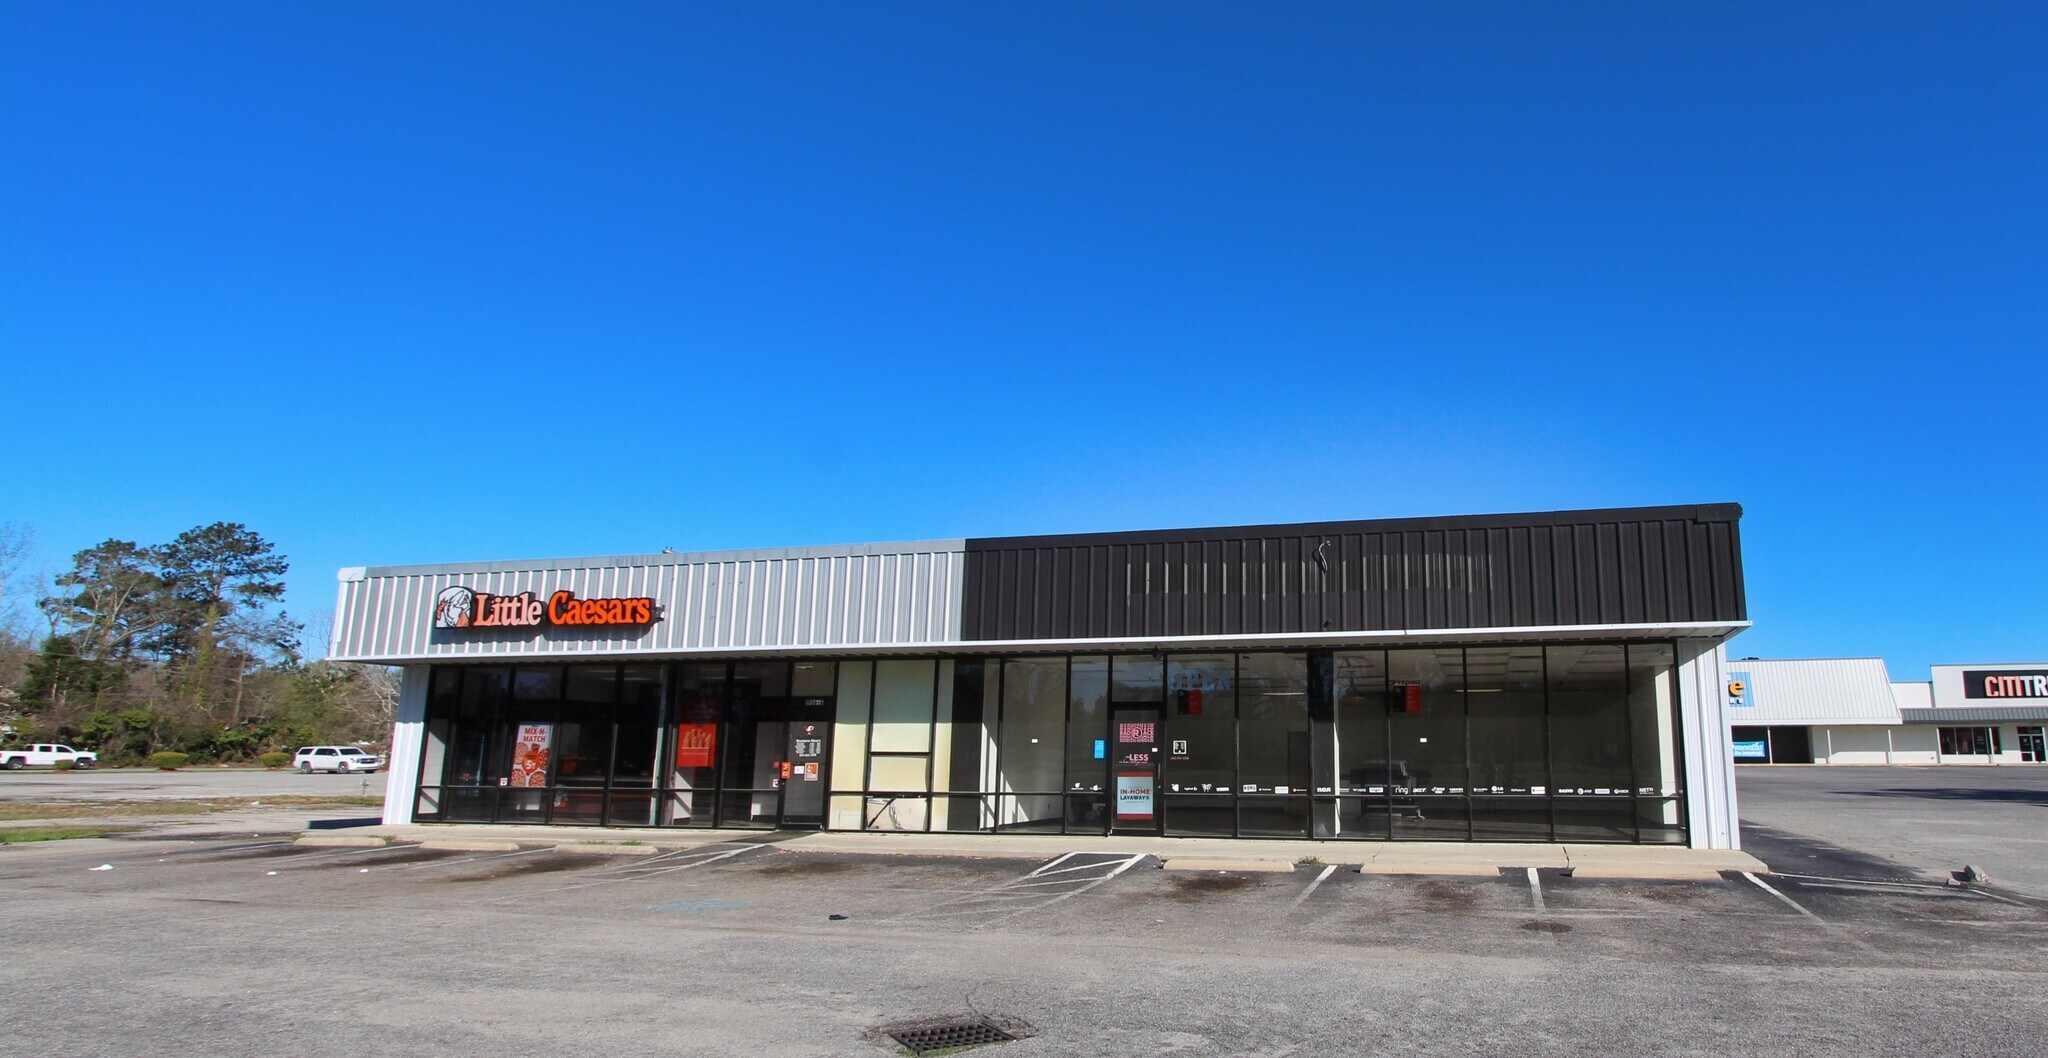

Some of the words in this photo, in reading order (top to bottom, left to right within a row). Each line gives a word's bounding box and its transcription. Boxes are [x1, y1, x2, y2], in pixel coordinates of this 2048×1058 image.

[473, 592, 542, 627] Little
[550, 590, 650, 626] Caesars
[1984, 675, 2048, 697] CITITR
[523, 735, 546, 743] MATCH
[1129, 753, 1149, 761] LESS
[1395, 786, 1409, 795] ring
